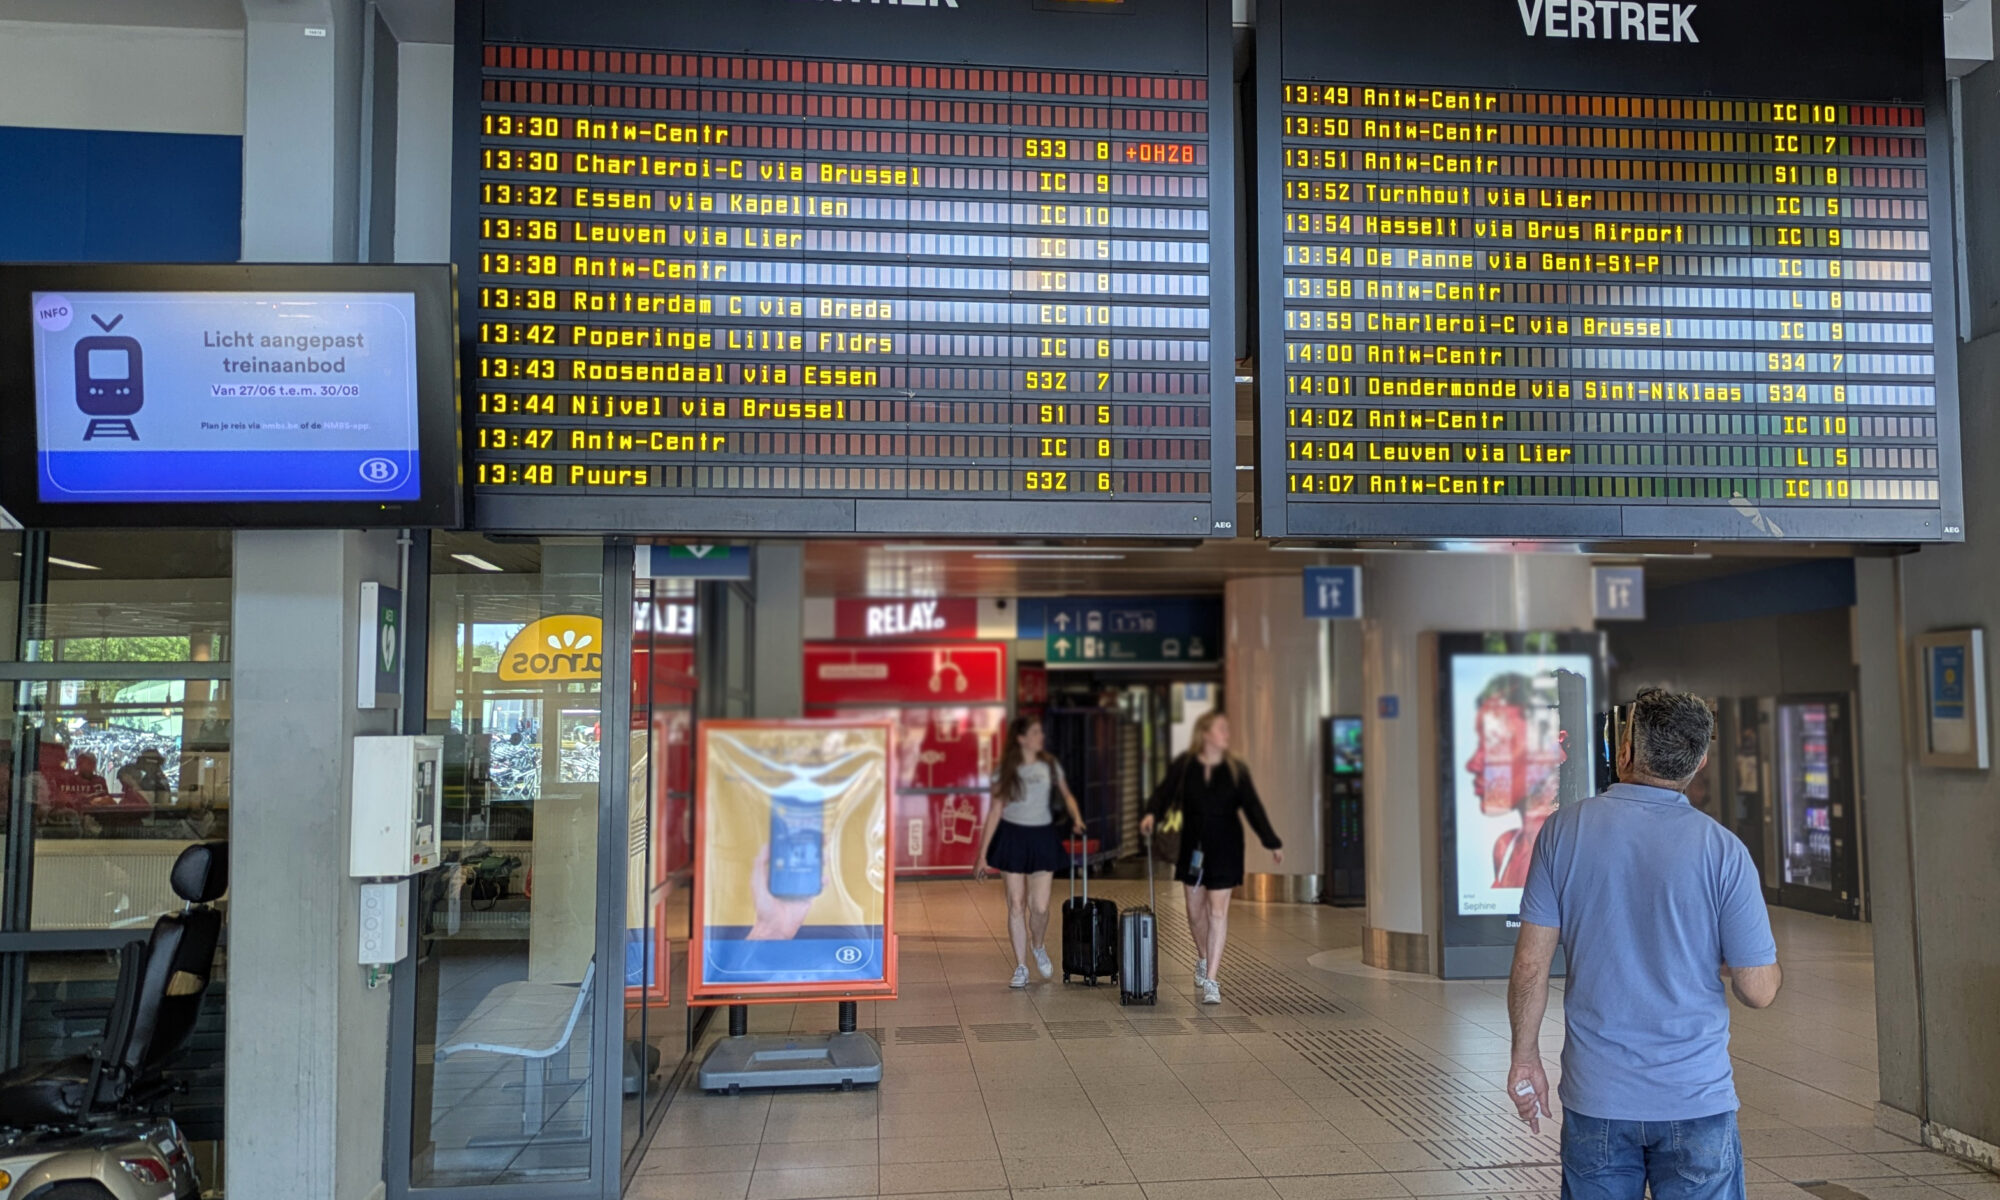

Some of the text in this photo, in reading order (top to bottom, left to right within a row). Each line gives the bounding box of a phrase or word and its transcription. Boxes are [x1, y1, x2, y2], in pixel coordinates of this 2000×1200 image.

[1518, 0, 1700, 43] VERTREK
[1285, 86, 1836, 124] 13:49 Antw-Centr IC 10
[485, 116, 1195, 164] 13:30 Antw-Centr S33 8 +0H28
[1286, 118, 1837, 155] 13:50 Antw-Centr IC 7
[485, 151, 1110, 195] 13:30 Charleroi-C via Brussel IC 9
[1286, 150, 1839, 186] 13:51 Antw-Centr S1 8
[485, 185, 1110, 227] 13:32 Essen via Kapellen IC 10
[1286, 182, 1840, 217] 13:52 Turnhout via Lier IC 5
[484, 220, 1110, 259] 13:36 Leuven via Lier IC 5
[1286, 214, 1841, 247] 13:54 Hasselt via Brus Airport IC 9
[483, 255, 1110, 292] 13:38 Antw-Centr IC 8
[1287, 246, 1842, 279] 13:54 De Panne via Gent-St-P IC 6
[482, 289, 1110, 325] 13:38 Rotterdam C via Breda EC 10
[1287, 279, 1843, 310] 13:58 Antw-Centr L 8
[39, 306, 69, 320] INFO
[1287, 312, 1844, 341] 13:59 Charleroi-C via Brussel IC 9
[204, 330, 365, 351] Licht aangepast
[482, 325, 1111, 359] 13:42 Poperinge Lille Fldrs IC 6
[222, 356, 346, 373] treinaanbod
[1288, 344, 1844, 372] 14:00 Antw-Centr S34 7
[211, 384, 360, 397] Van 27/06 t.e.m. 30/08
[481, 359, 1111, 392] 13:43 Roosendaal via Essen S32 7
[1288, 377, 1847, 404] 14:01 Dendermonde via Sint-Niklaas S34 6
[480, 394, 1111, 425] 13:44 Nijvel via Brussel S1 5
[1289, 410, 1848, 436] 14:02 Antw-Centr IC 10
[201, 421, 220, 431] Plan
[220, 421, 229, 433] je
[230, 421, 246, 431] reis
[247, 421, 261, 431] via
[300, 421, 309, 431] of
[311, 421, 322, 431] de
[480, 430, 1111, 458] 13:47 Antw-Centr IC 8
[1290, 443, 1849, 467] 14:04 Leuven via Lier L 5
[479, 465, 1111, 491] 13:48 Puurs S32 6
[1290, 475, 1850, 500] 14:07 Antw-Centr IC 10
[1213, 520, 1232, 529] AEG
[1943, 526, 1960, 534] AEG
[866, 600, 938, 637] RELAY
[910, 823, 921, 851] GIFTS
